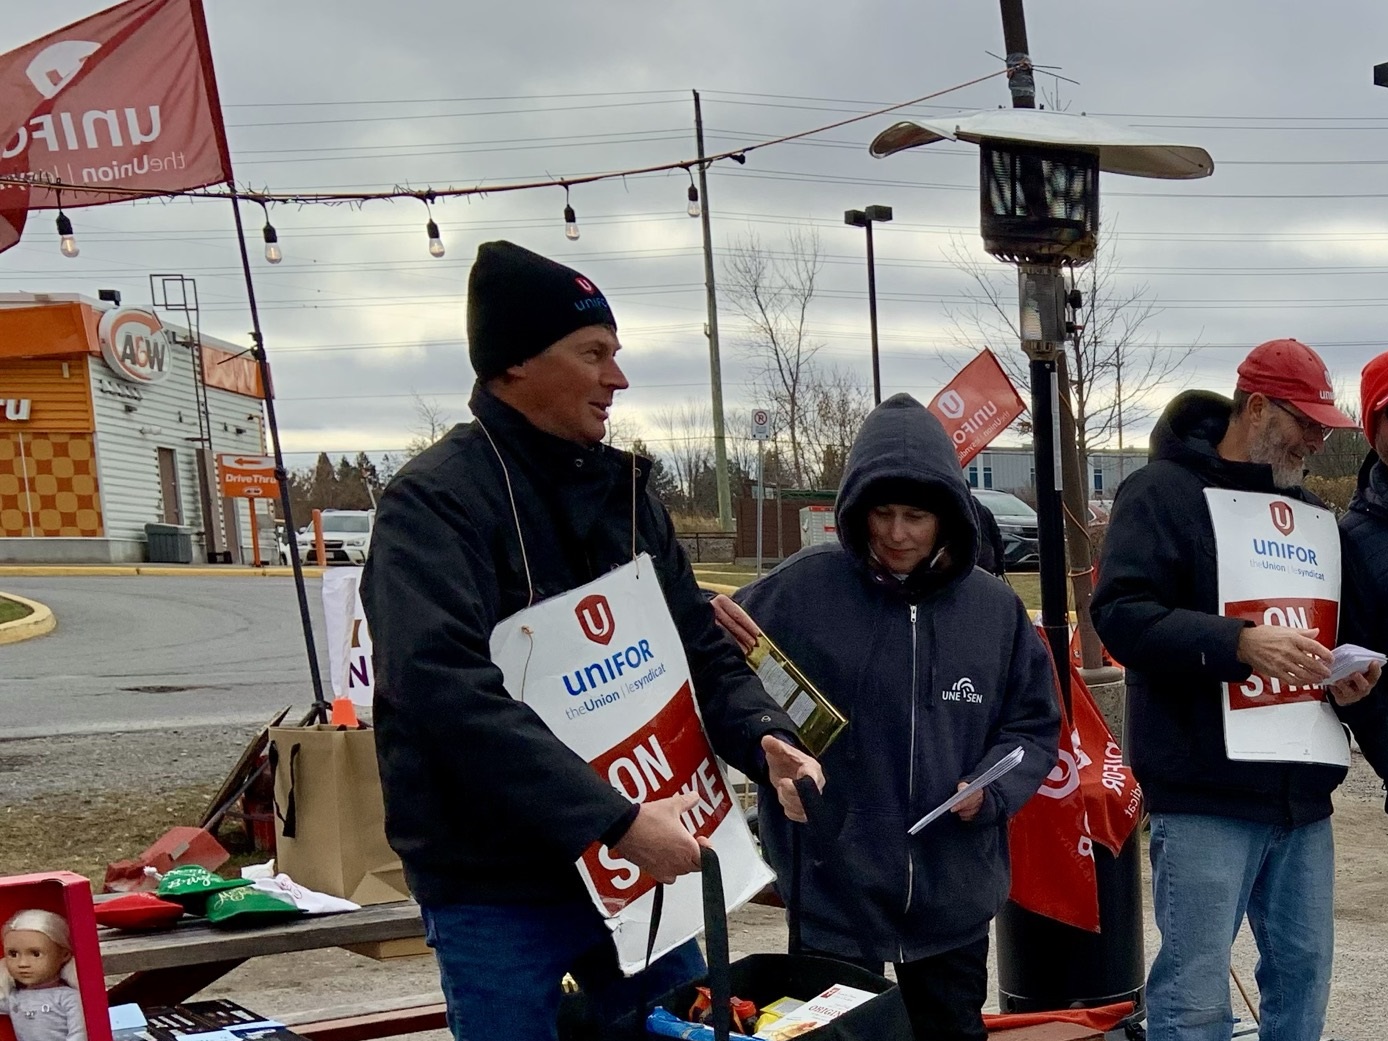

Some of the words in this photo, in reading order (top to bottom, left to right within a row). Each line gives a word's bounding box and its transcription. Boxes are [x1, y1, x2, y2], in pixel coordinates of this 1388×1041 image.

[120, 330, 166, 373] A&W
[941, 690, 961, 702] UNE
[966, 691, 983, 704] SEN
[607, 733, 674, 806] ON
